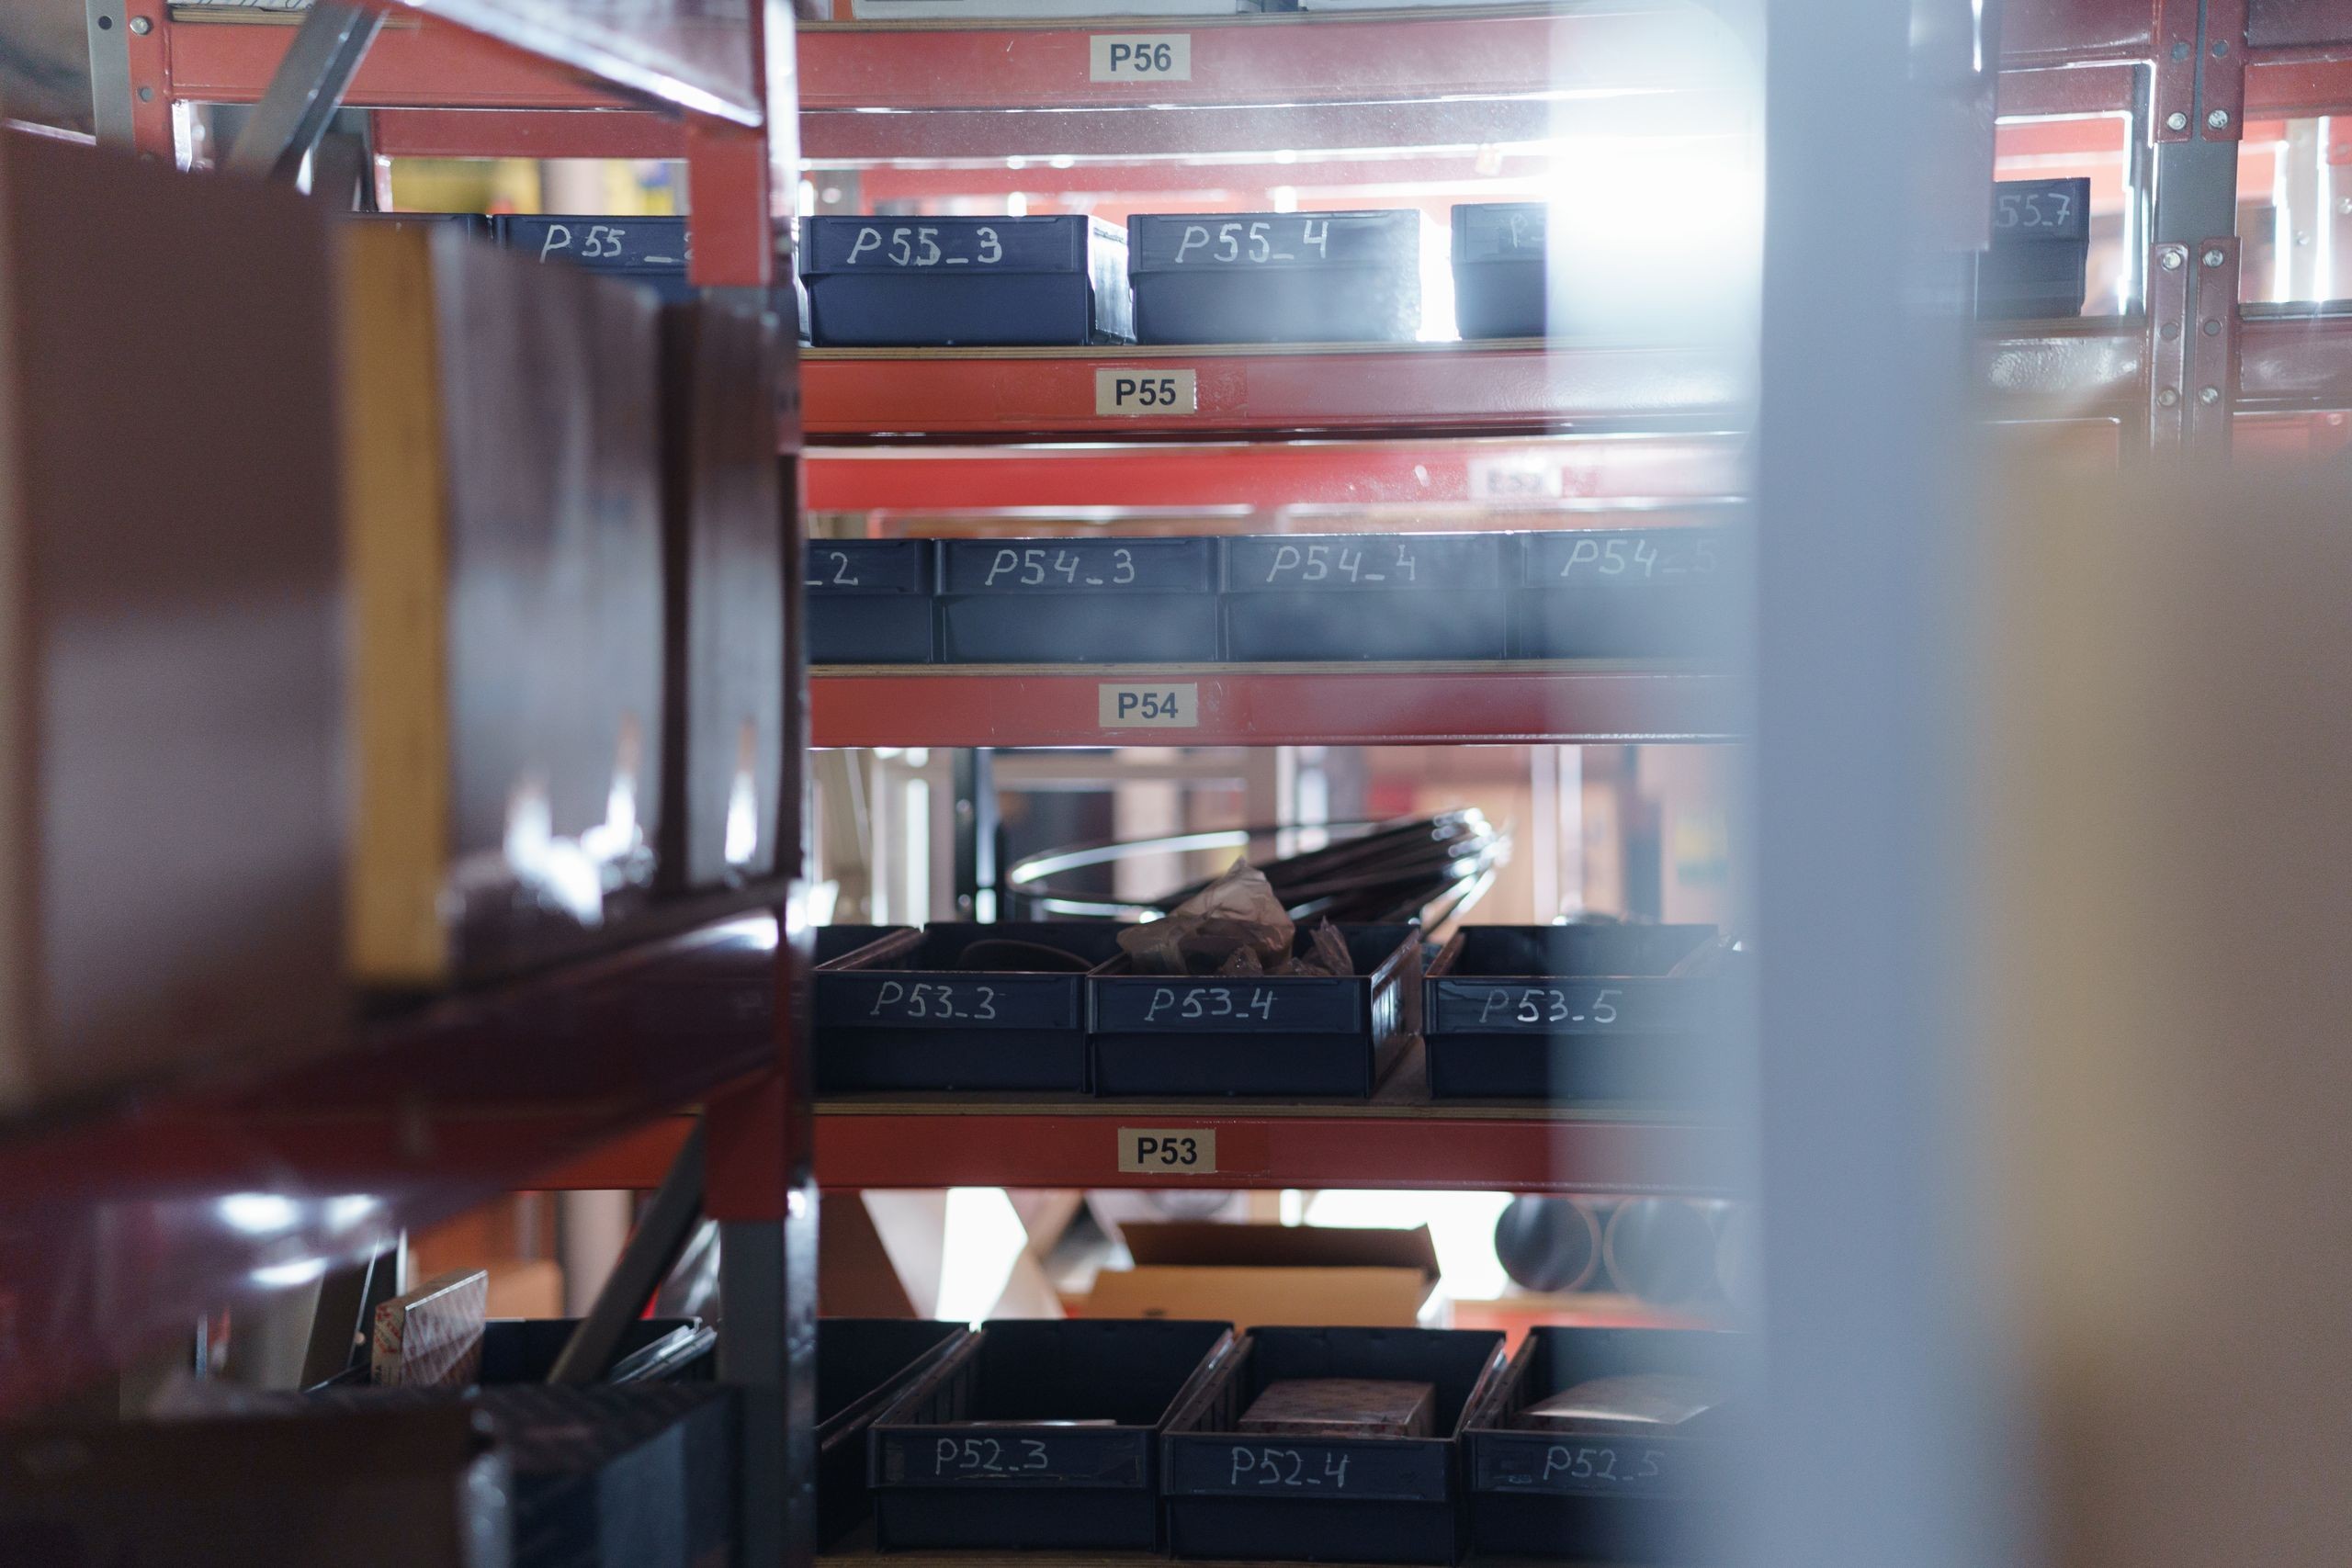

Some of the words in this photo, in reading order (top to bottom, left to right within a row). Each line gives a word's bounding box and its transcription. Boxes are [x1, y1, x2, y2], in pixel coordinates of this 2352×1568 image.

[1109, 43, 1171, 73] P56
[1995, 192, 2071, 228] 55_7
[846, 227, 1003, 266] P55_3
[1175, 220, 1329, 264] P55_4
[1114, 378, 1177, 406] P55
[985, 548, 1136, 586] P54_3
[1266, 545, 1417, 582] P54_4
[1117, 692, 1180, 719] P54
[1144, 987, 1278, 1021] P53_4
[1136, 1136, 1198, 1165] P53
[935, 1438, 1048, 1475] P52_3
[1231, 1446, 1351, 1489] P52_4
